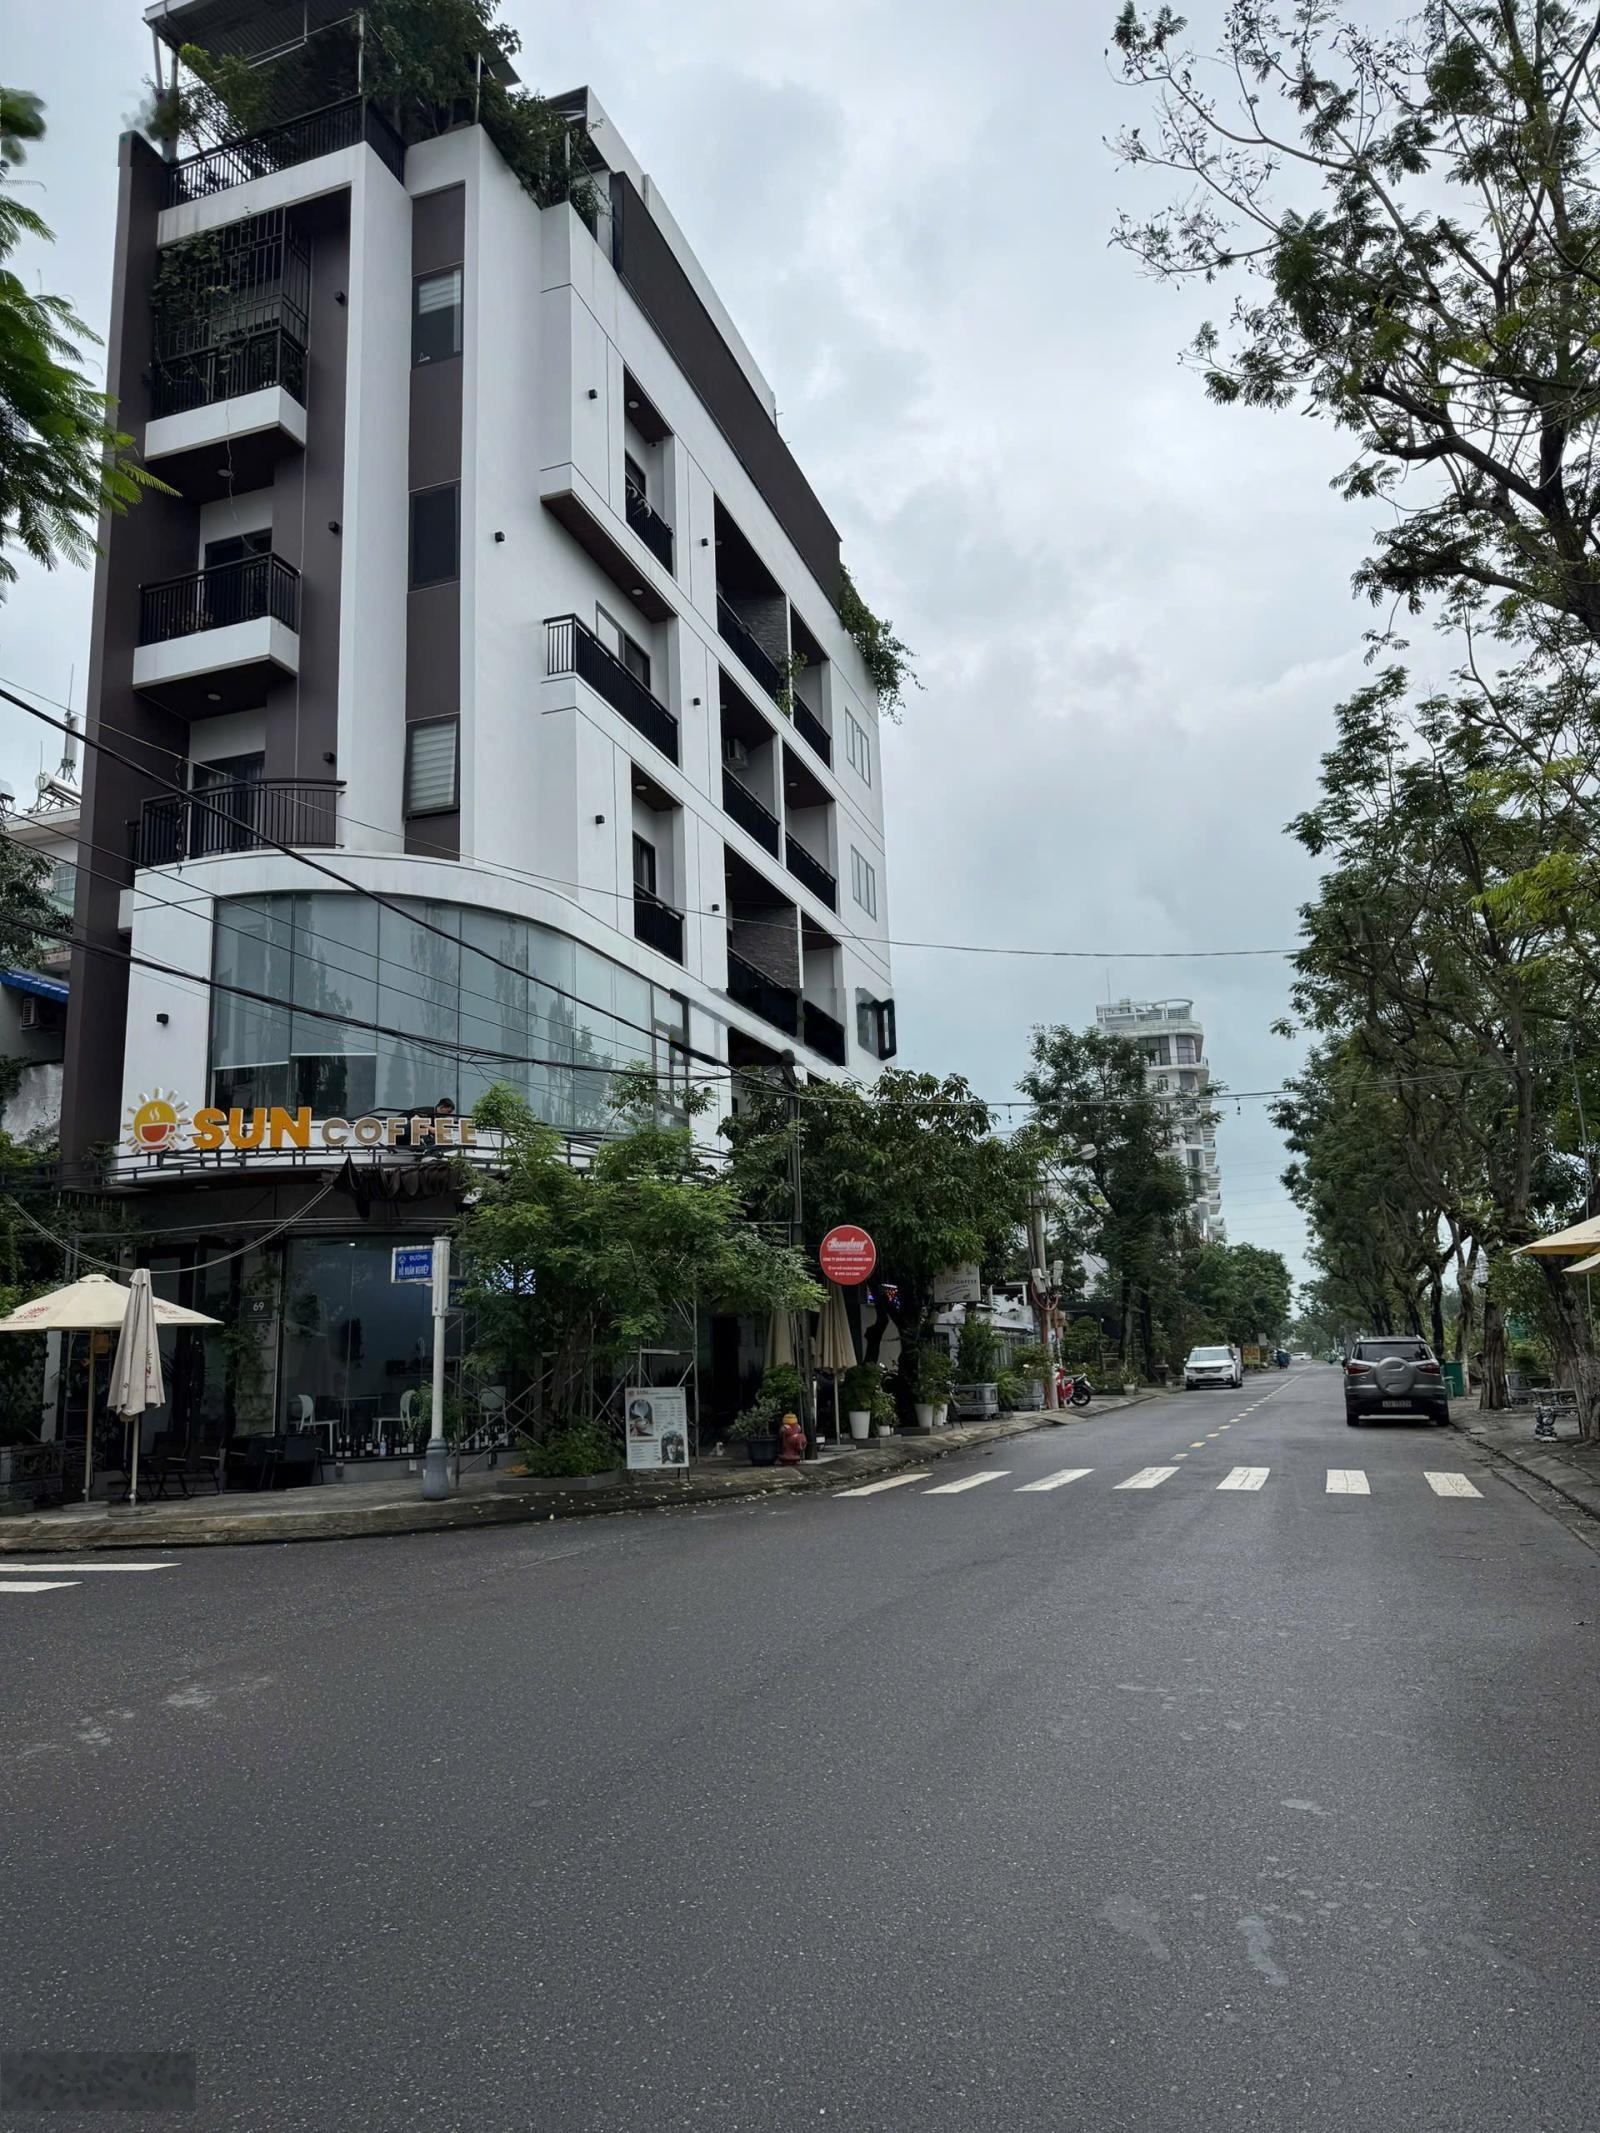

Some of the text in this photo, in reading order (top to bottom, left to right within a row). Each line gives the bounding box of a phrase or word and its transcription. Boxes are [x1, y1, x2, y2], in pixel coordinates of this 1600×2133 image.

[191, 1106, 478, 1149] SUN COFFEE
[253, 1301, 265, 1311] 69
